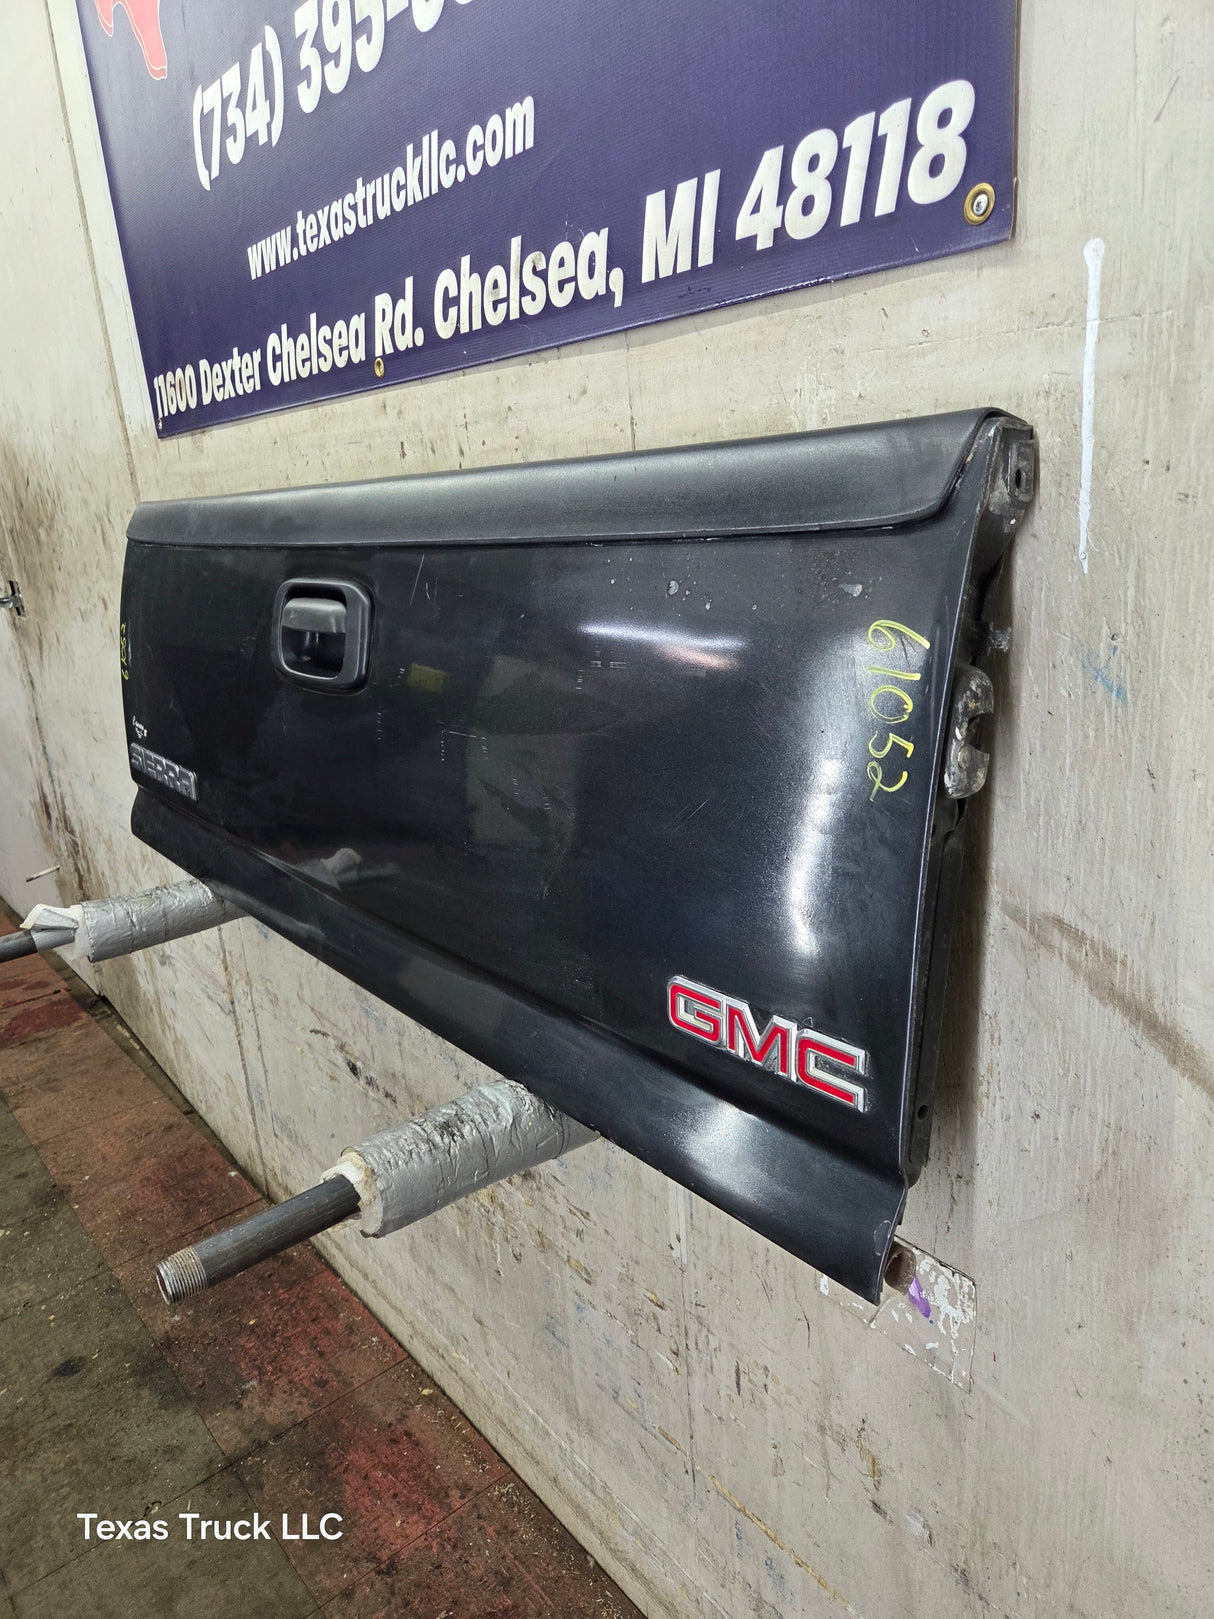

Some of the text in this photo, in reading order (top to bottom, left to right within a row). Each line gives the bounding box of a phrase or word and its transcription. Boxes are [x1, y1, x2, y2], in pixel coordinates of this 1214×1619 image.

[192, 0, 472, 190] (734) 395-
[247, 95, 535, 280] www.texastruckllc.com
[153, 79, 976, 418] 11600 Dexter Chelsea Rd. Chelsea, MI 48118
[866, 619, 931, 801] 61052
[667, 975, 868, 1113] GMC
